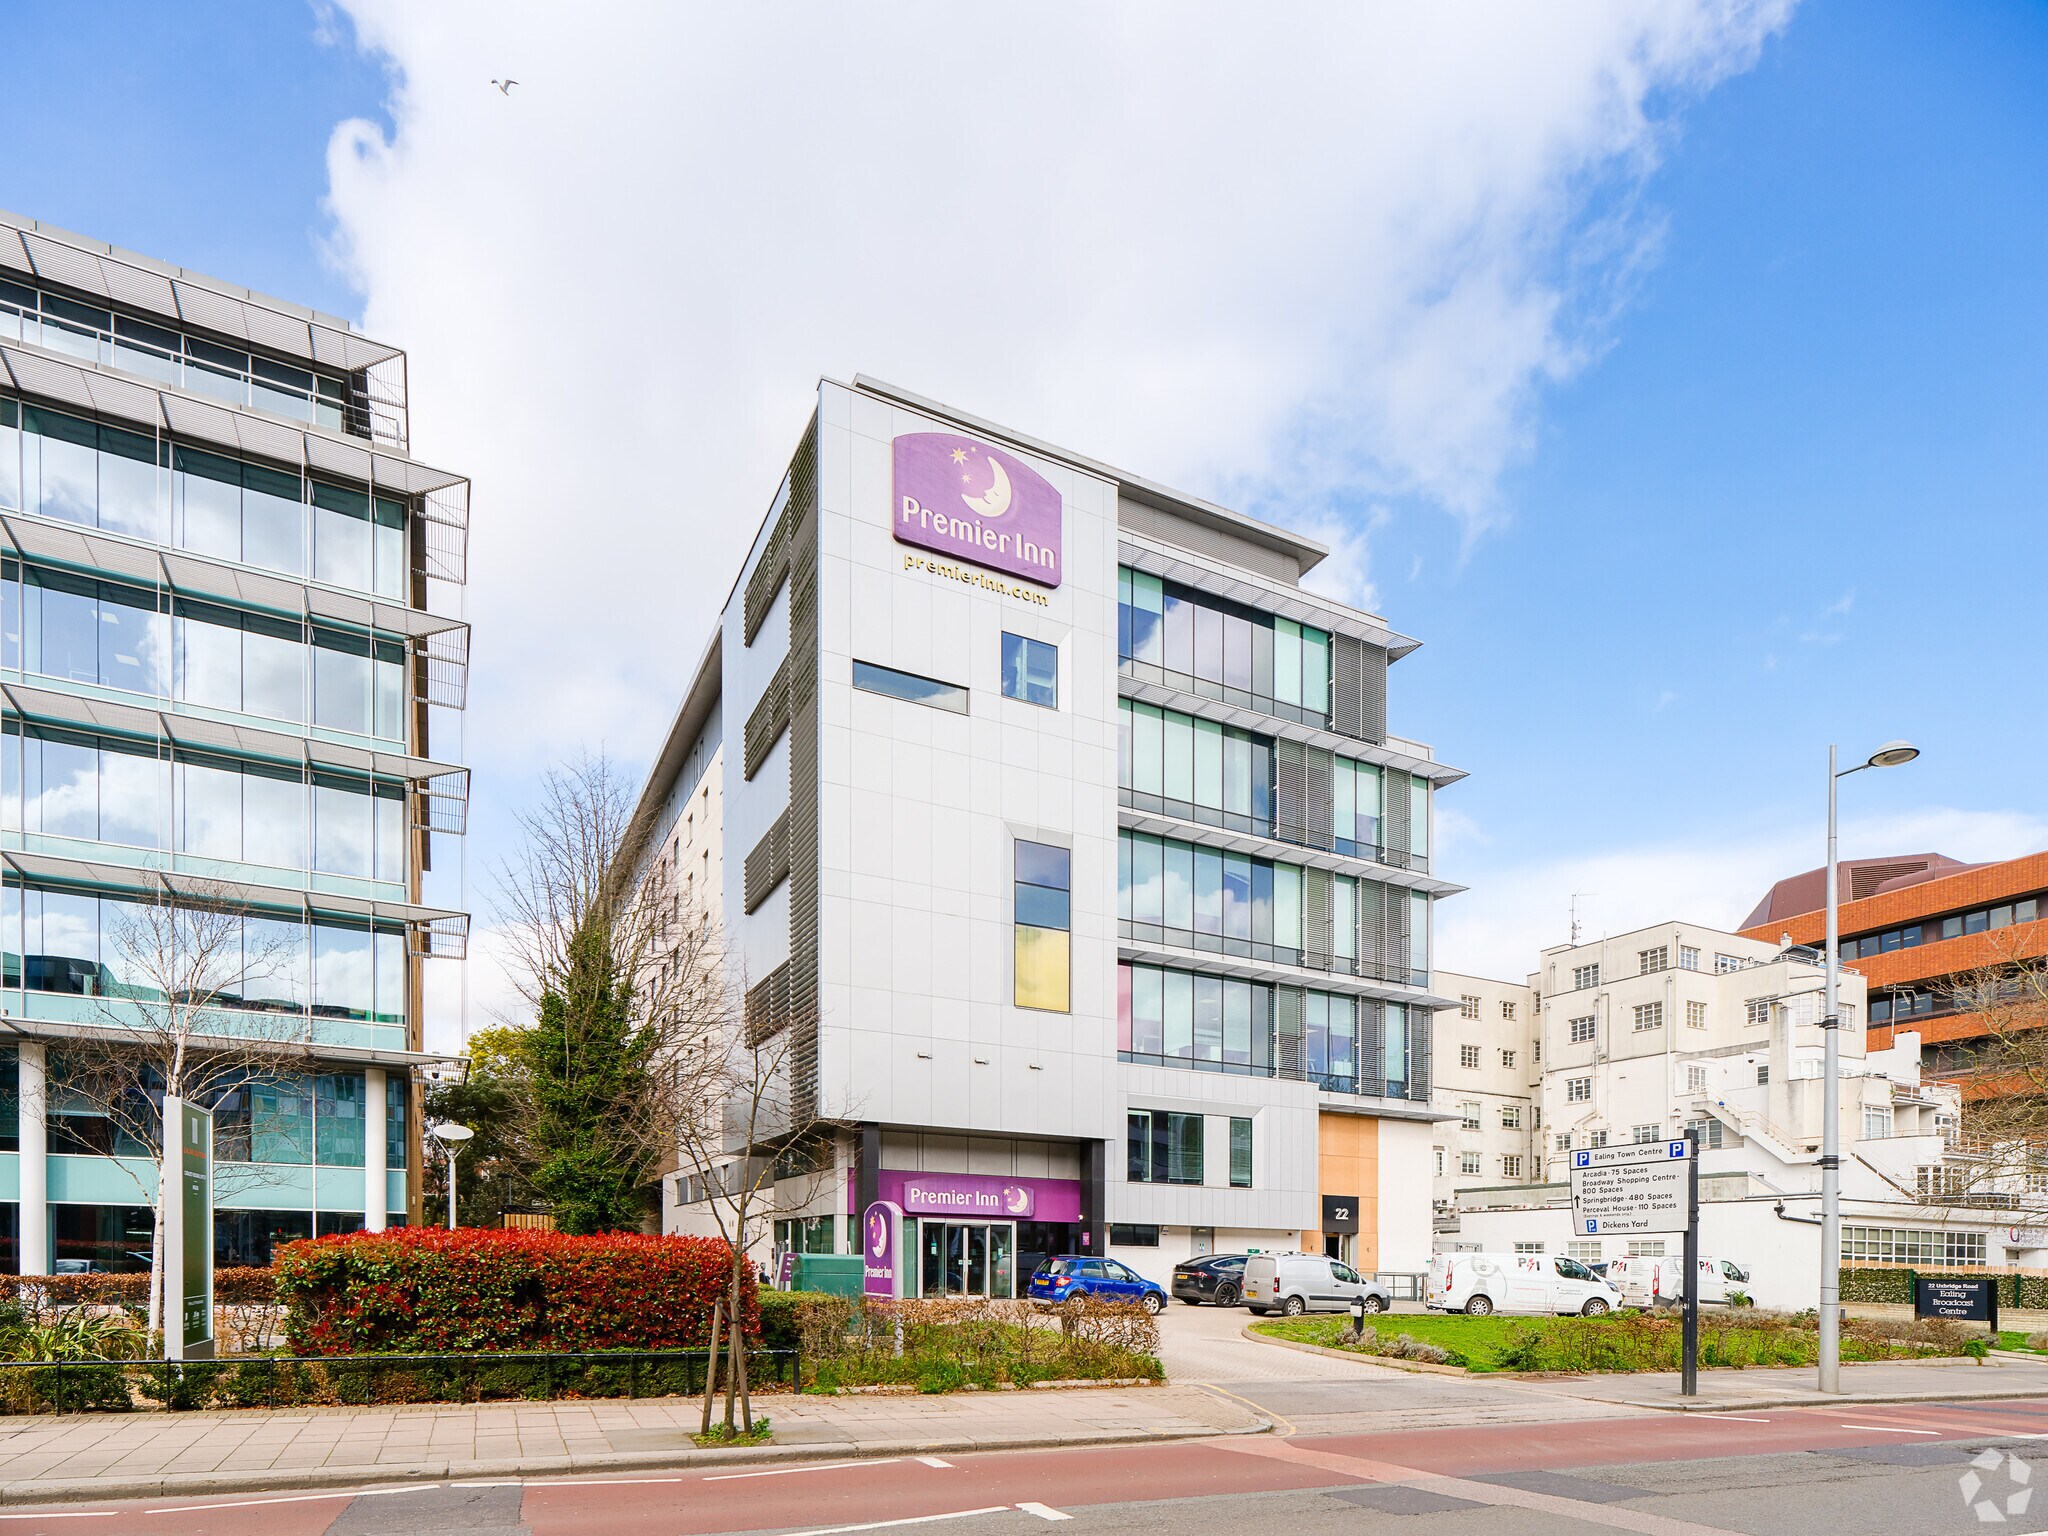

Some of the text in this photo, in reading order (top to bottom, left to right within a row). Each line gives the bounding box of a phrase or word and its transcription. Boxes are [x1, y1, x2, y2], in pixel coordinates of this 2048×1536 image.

[902, 496, 1055, 570] Premier Inn
[903, 553, 1049, 607] premierinn.com
[1638, 1148, 1663, 1156] Centre
[1622, 1167, 1648, 1175] Spaces
[1582, 1179, 1614, 1187] Broadway
[1617, 1176, 1650, 1184] Shopping
[1599, 1186, 1623, 1194] Spaces
[911, 1187, 999, 1207] Premier Inn
[1582, 1205, 1610, 1213] Perceval
[1651, 1202, 1677, 1210] Spaces
[1335, 1208, 1349, 1219] 22
[1602, 1221, 1630, 1229] Dickens
[1631, 1219, 1649, 1228] Yard
[864, 1264, 892, 1278] Premier Inn
[1939, 1290, 1967, 1299] Ealing
[1932, 1299, 1974, 1307] Broadcast
[1938, 1307, 1968, 1315] Centre
